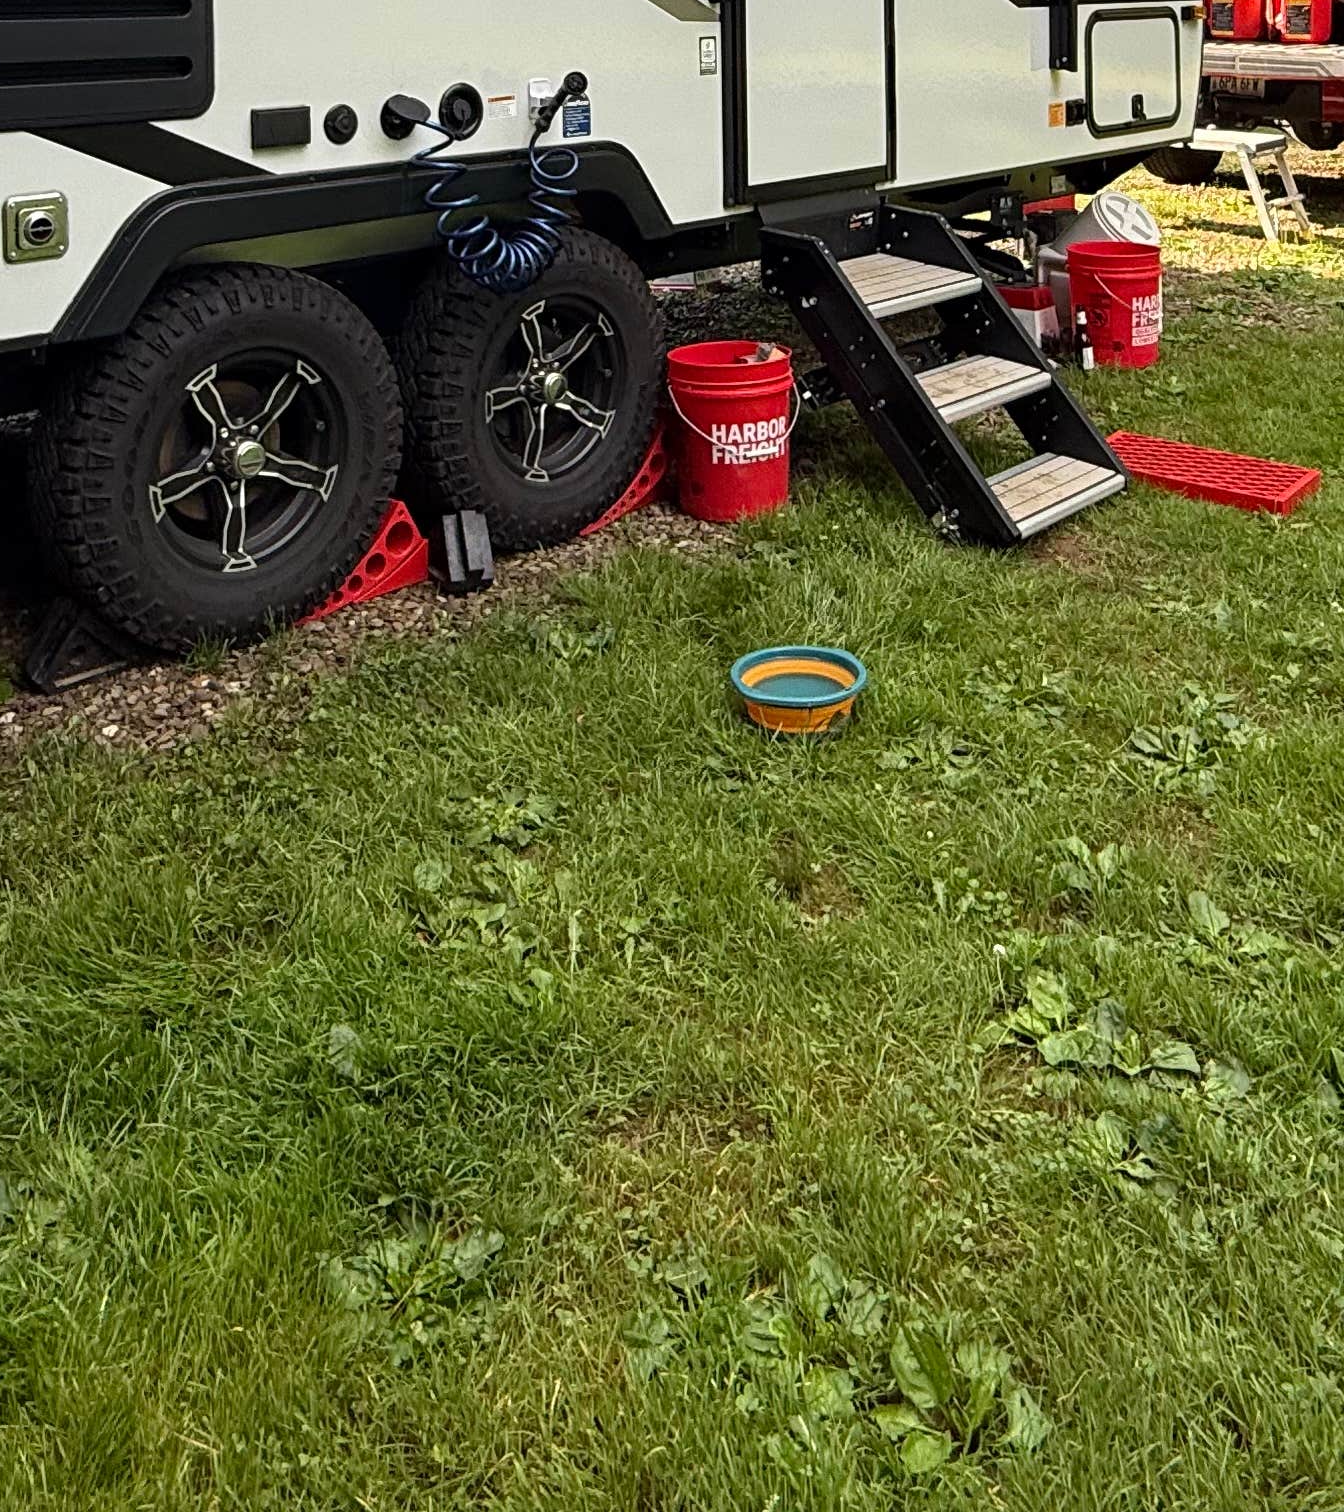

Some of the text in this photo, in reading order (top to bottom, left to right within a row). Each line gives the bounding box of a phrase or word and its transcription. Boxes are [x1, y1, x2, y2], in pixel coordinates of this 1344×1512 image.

[1132, 294, 1160, 311] HAR
[711, 415, 787, 444] HARBOR
[711, 437, 786, 465] FREIGHT
